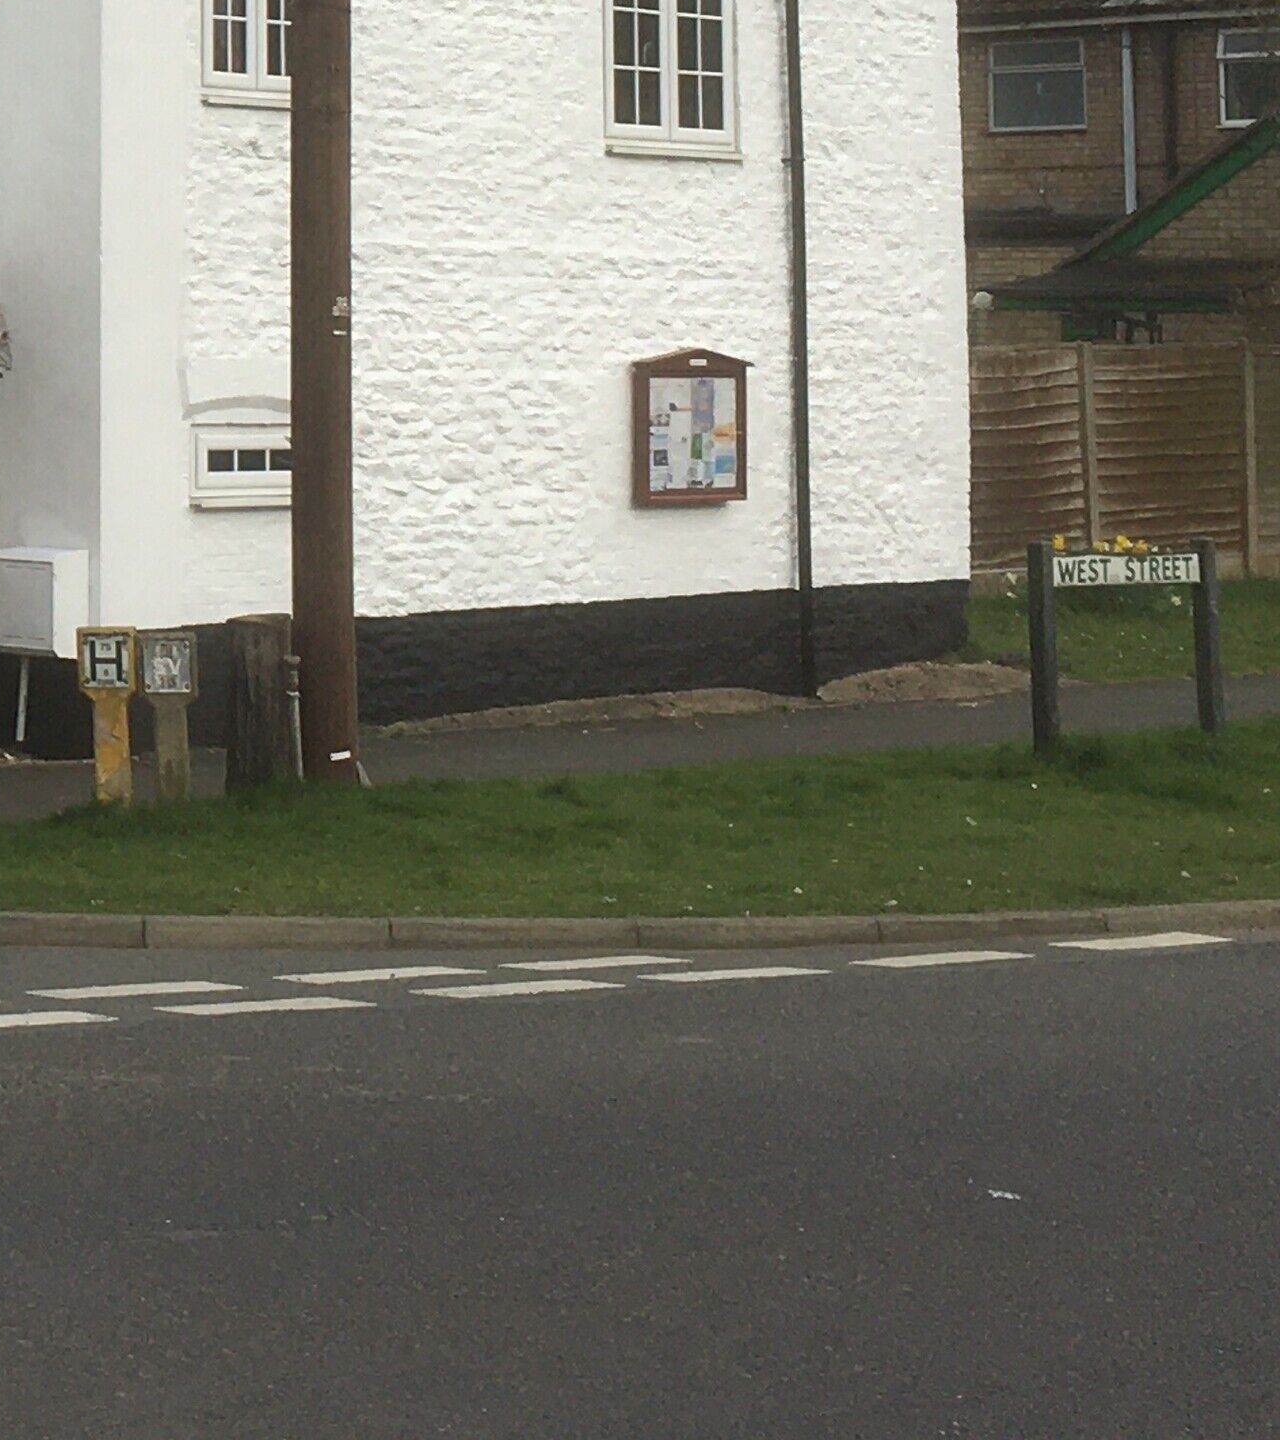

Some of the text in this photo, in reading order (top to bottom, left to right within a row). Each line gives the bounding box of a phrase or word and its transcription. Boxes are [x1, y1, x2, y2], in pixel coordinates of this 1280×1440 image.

[1058, 556, 1193, 583] WEST STREET
[89, 640, 123, 681] H
